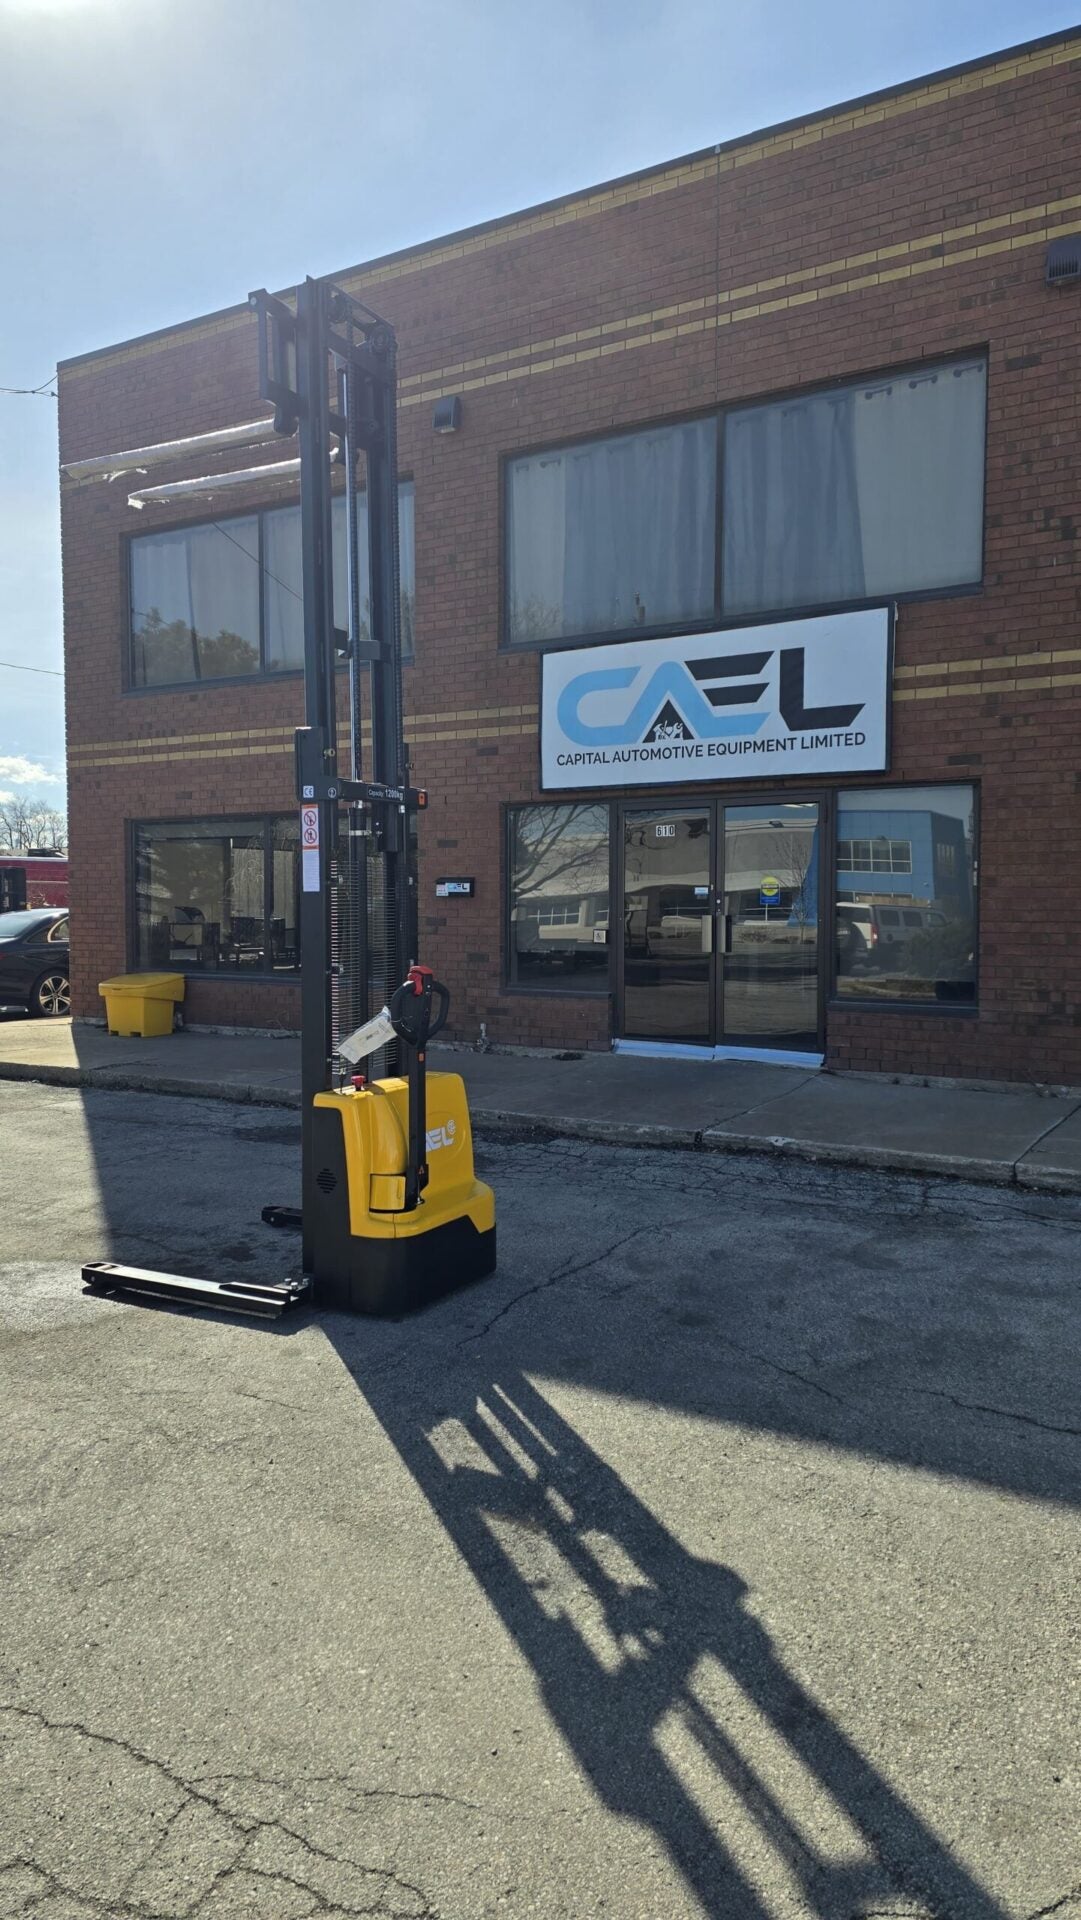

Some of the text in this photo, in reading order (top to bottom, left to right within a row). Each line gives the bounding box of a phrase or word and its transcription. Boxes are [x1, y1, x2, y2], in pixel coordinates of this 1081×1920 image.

[557, 647, 866, 747] CAEL
[557, 732, 866, 766] CAPITAL AUTOMOTIVE EQUIPMENT LIMITED
[368, 789, 384, 798] Capacity
[656, 825, 675, 837] 610
